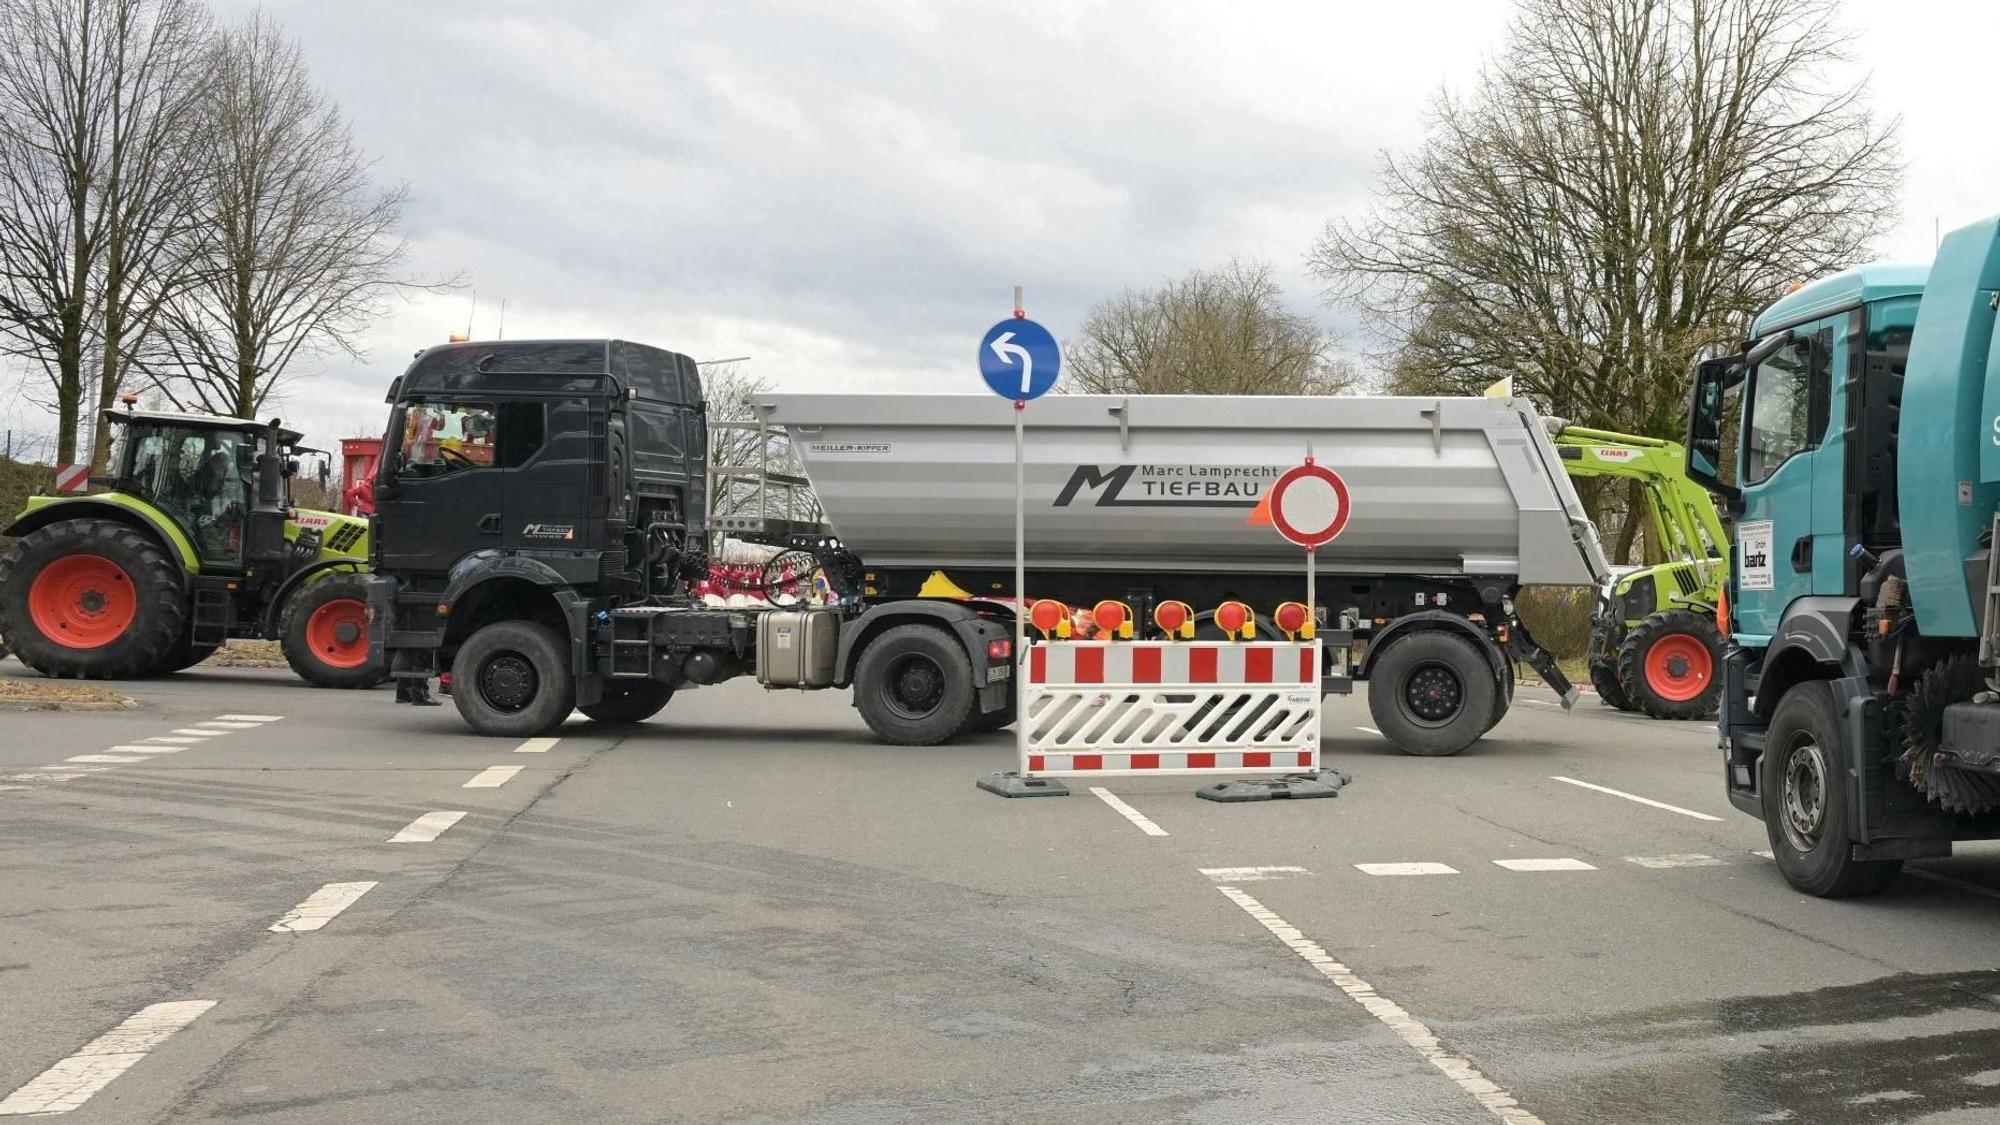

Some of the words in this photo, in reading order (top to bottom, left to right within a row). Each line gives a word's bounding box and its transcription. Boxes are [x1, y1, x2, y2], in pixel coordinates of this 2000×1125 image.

[1600, 449, 1629, 457] CLAAS
[1142, 464, 1183, 477] Marc
[1189, 464, 1278, 479] Lamprecht
[1142, 481, 1259, 496] TIEFBAU
[294, 517, 328, 526] CLAAS
[1744, 540, 1767, 568] bartz
